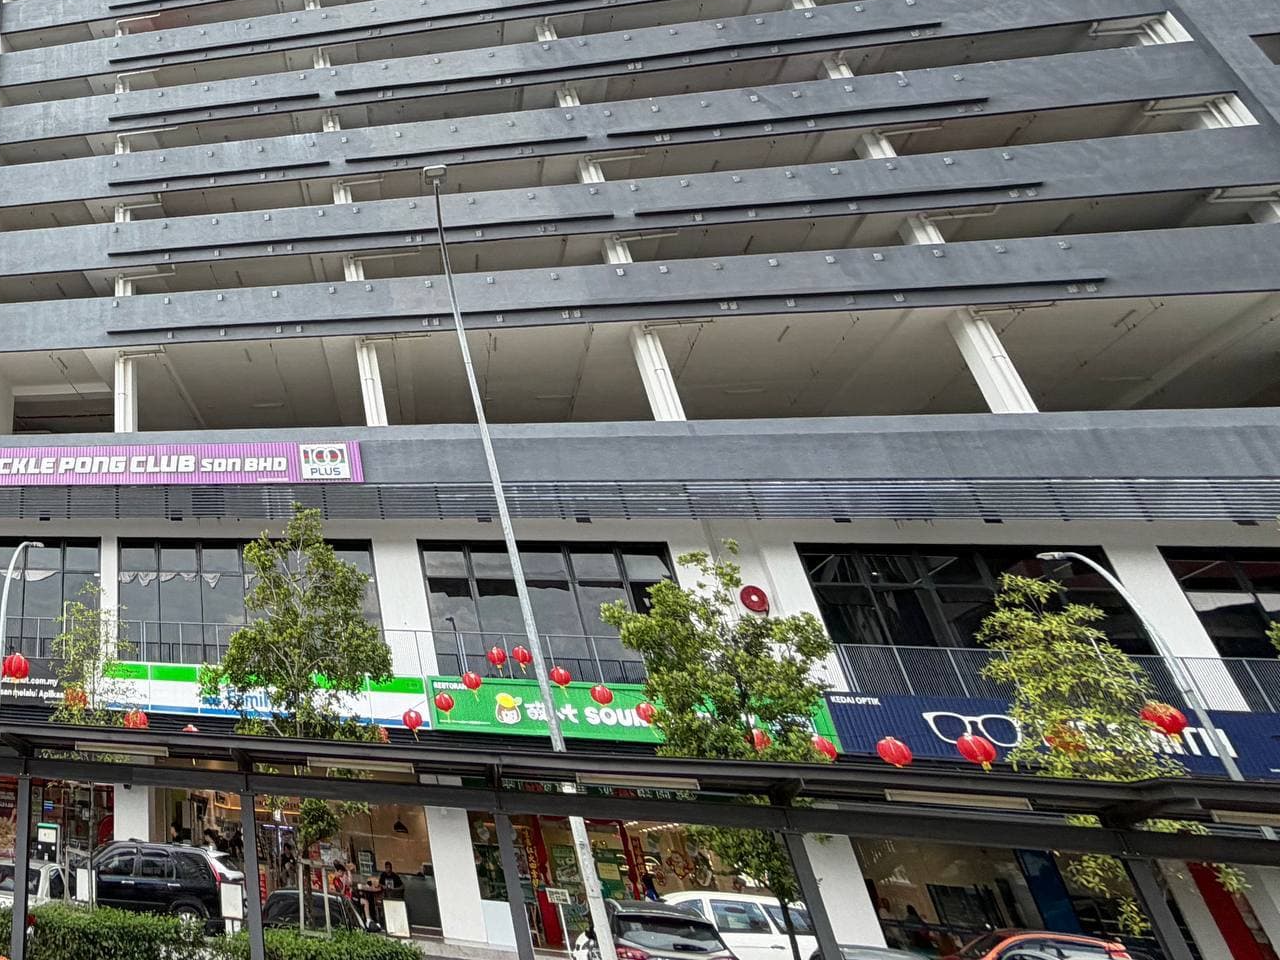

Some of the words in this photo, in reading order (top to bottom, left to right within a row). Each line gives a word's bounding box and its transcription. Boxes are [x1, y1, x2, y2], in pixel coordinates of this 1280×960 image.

[303, 446, 346, 465] 100
[58, 455, 128, 474] PONG
[129, 454, 196, 473] CLUB
[244, 456, 288, 472] BHD
[309, 466, 342, 477] PLUS
[830, 695, 855, 705] KEDAI
[856, 696, 881, 707] OPTIK
